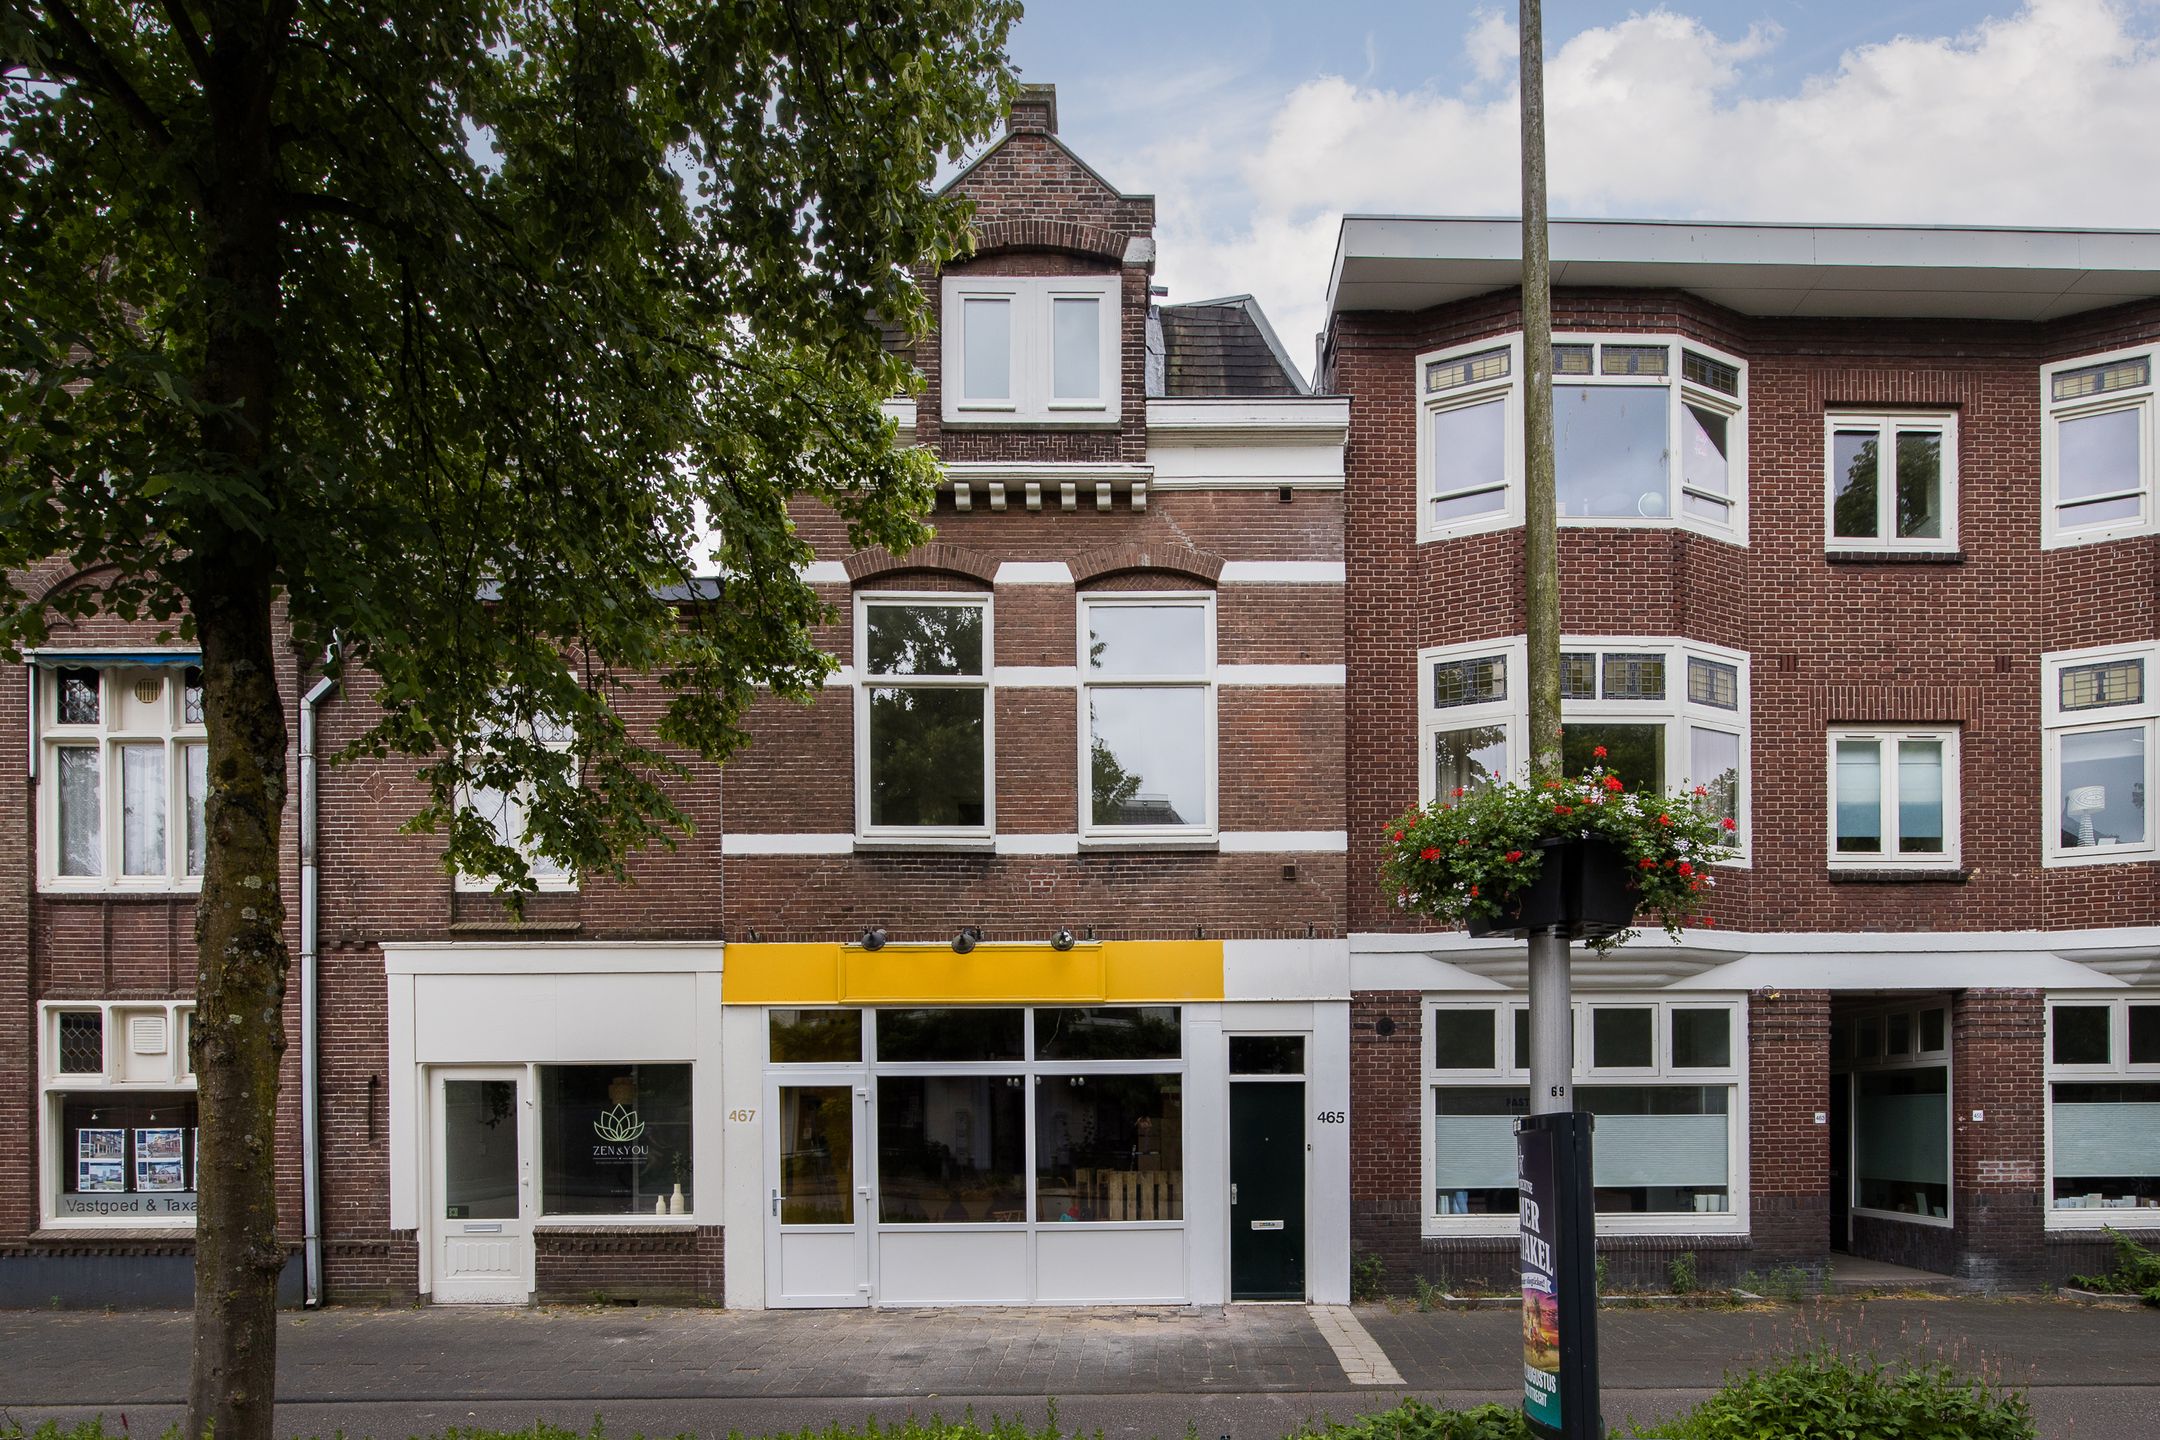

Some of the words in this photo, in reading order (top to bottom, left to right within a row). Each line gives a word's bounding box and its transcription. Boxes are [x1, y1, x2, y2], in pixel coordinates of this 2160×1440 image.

[728, 1109, 756, 1122] 467
[1317, 1111, 1345, 1124] 465
[66, 1199, 139, 1215] Vastgoed
[146, 1199, 157, 1212] &
